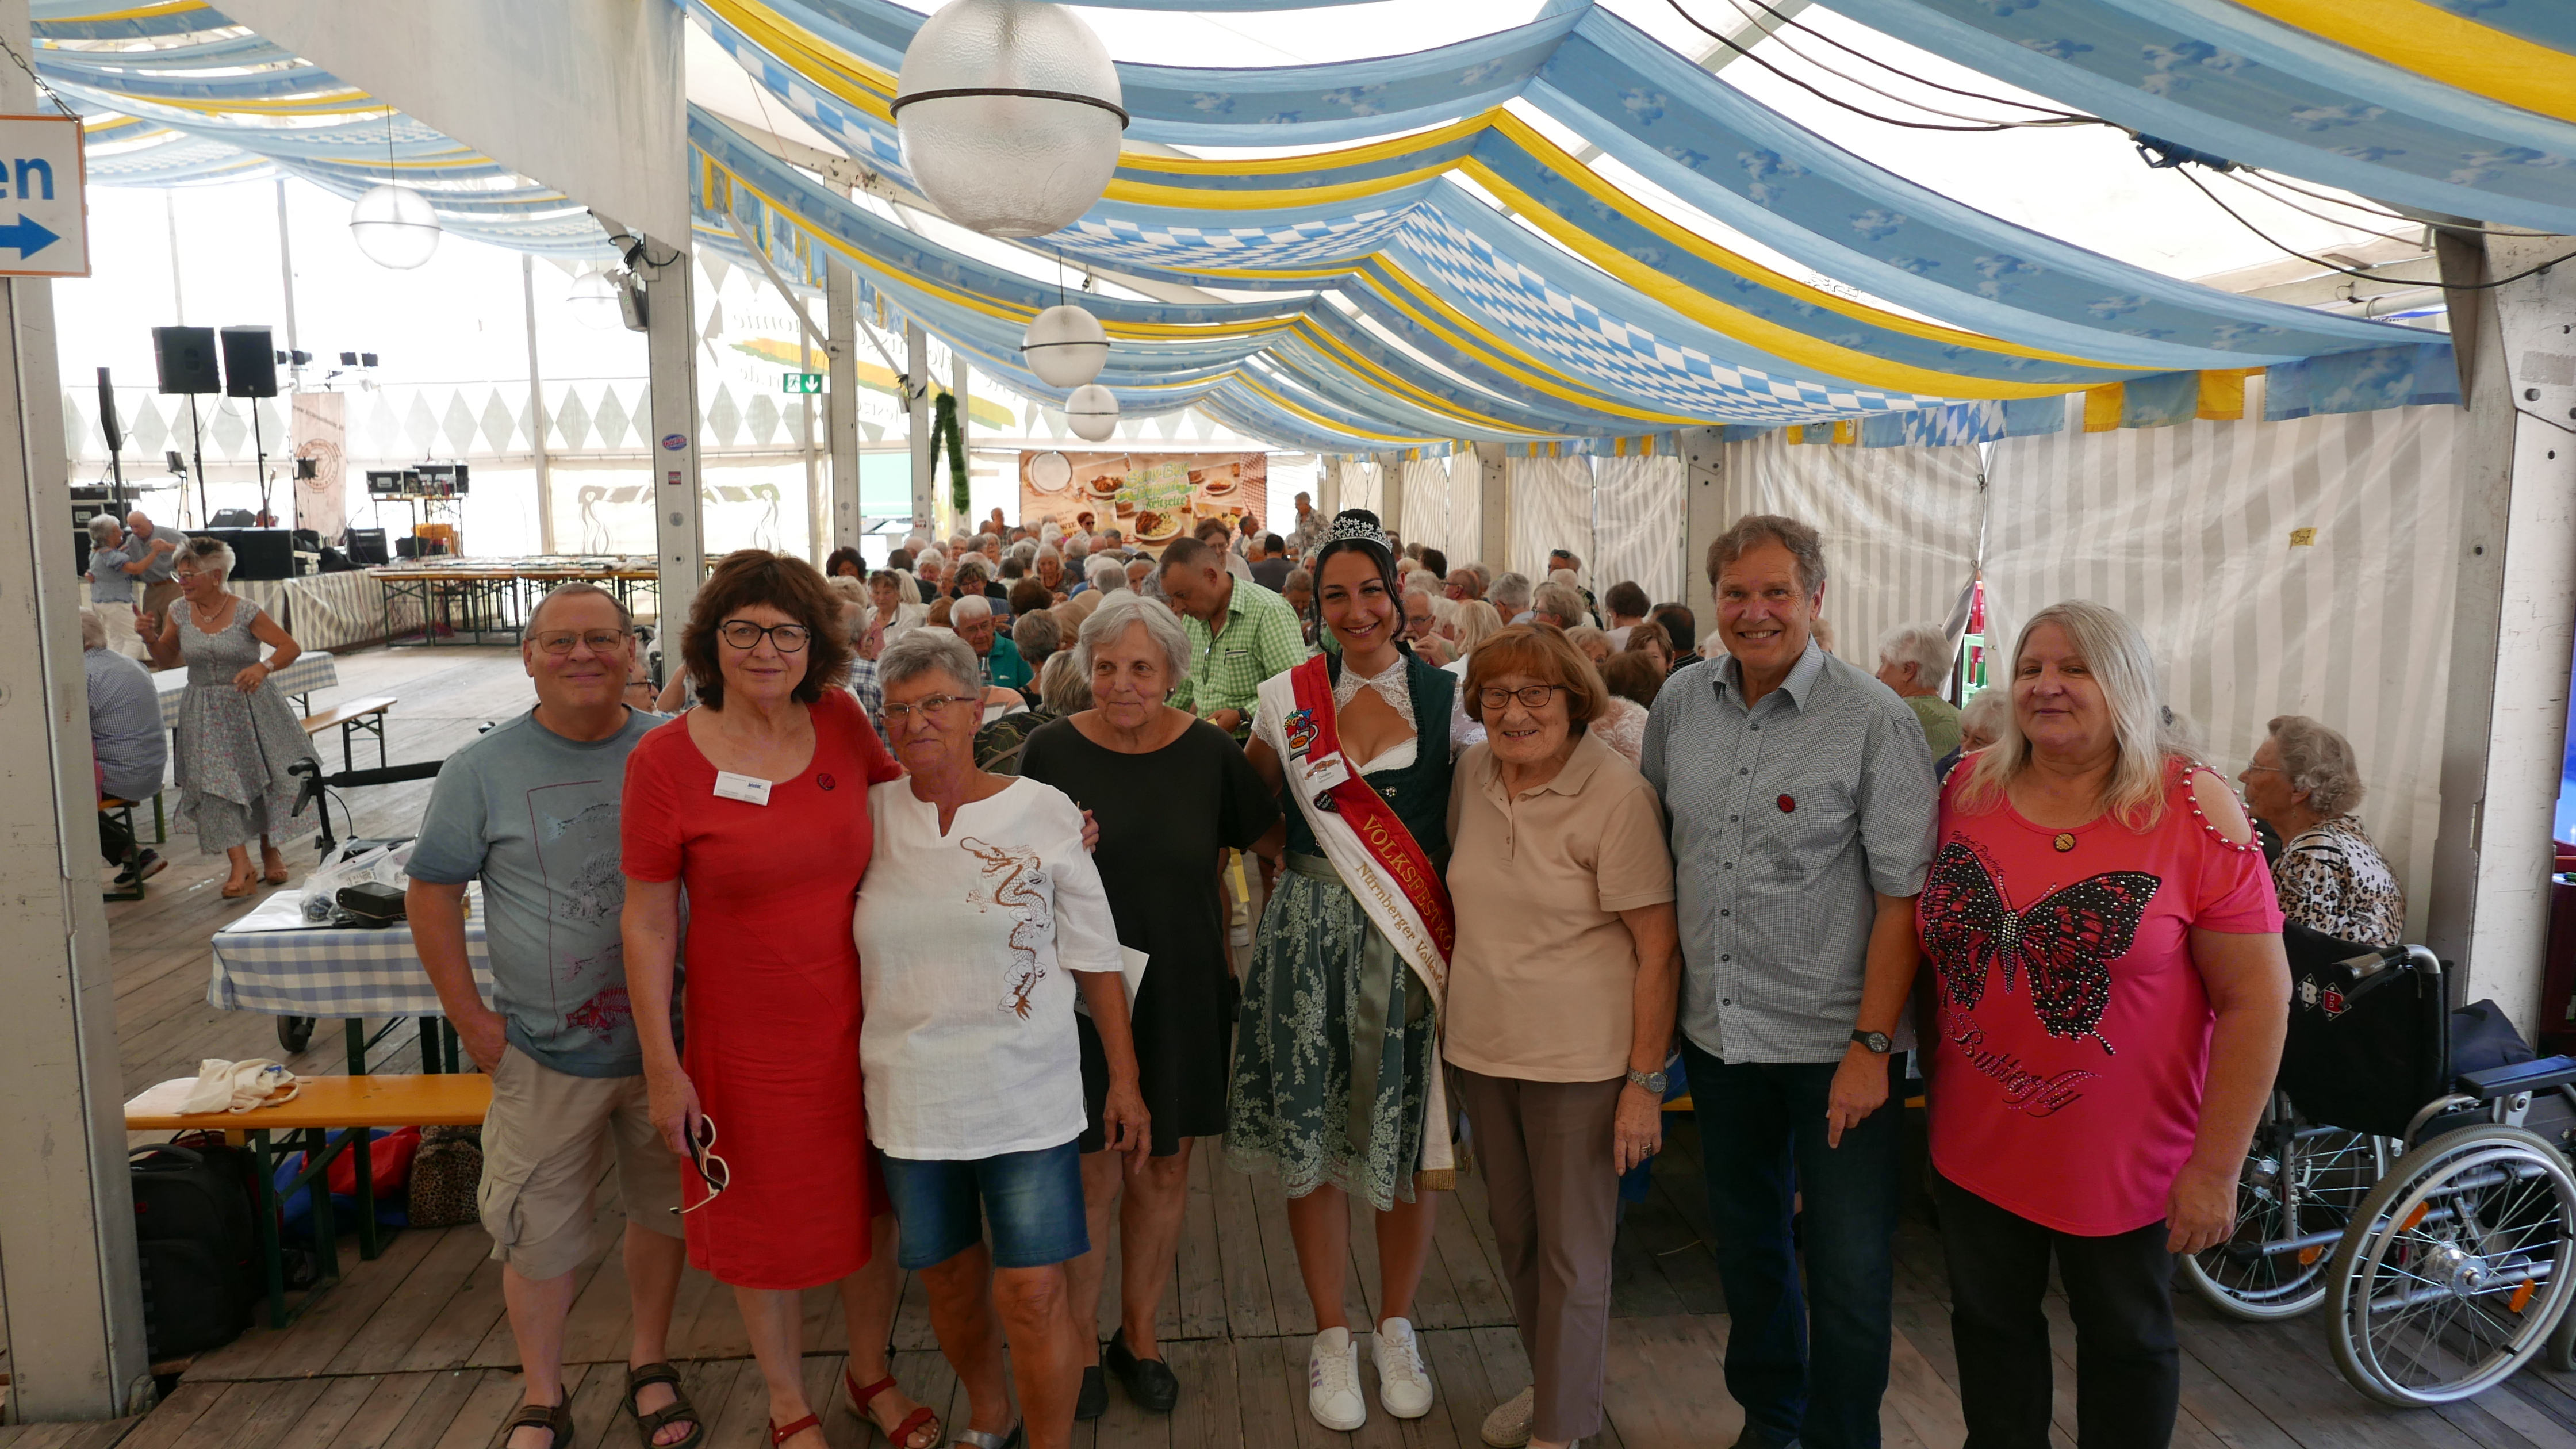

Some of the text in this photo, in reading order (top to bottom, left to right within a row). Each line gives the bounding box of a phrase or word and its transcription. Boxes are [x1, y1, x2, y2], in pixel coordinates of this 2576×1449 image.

[1356, 861, 1416, 941] Nürnberger
[1363, 814, 1455, 957] VOLKSFESTKÖ
[1943, 1008, 2102, 1118] Butterfly
